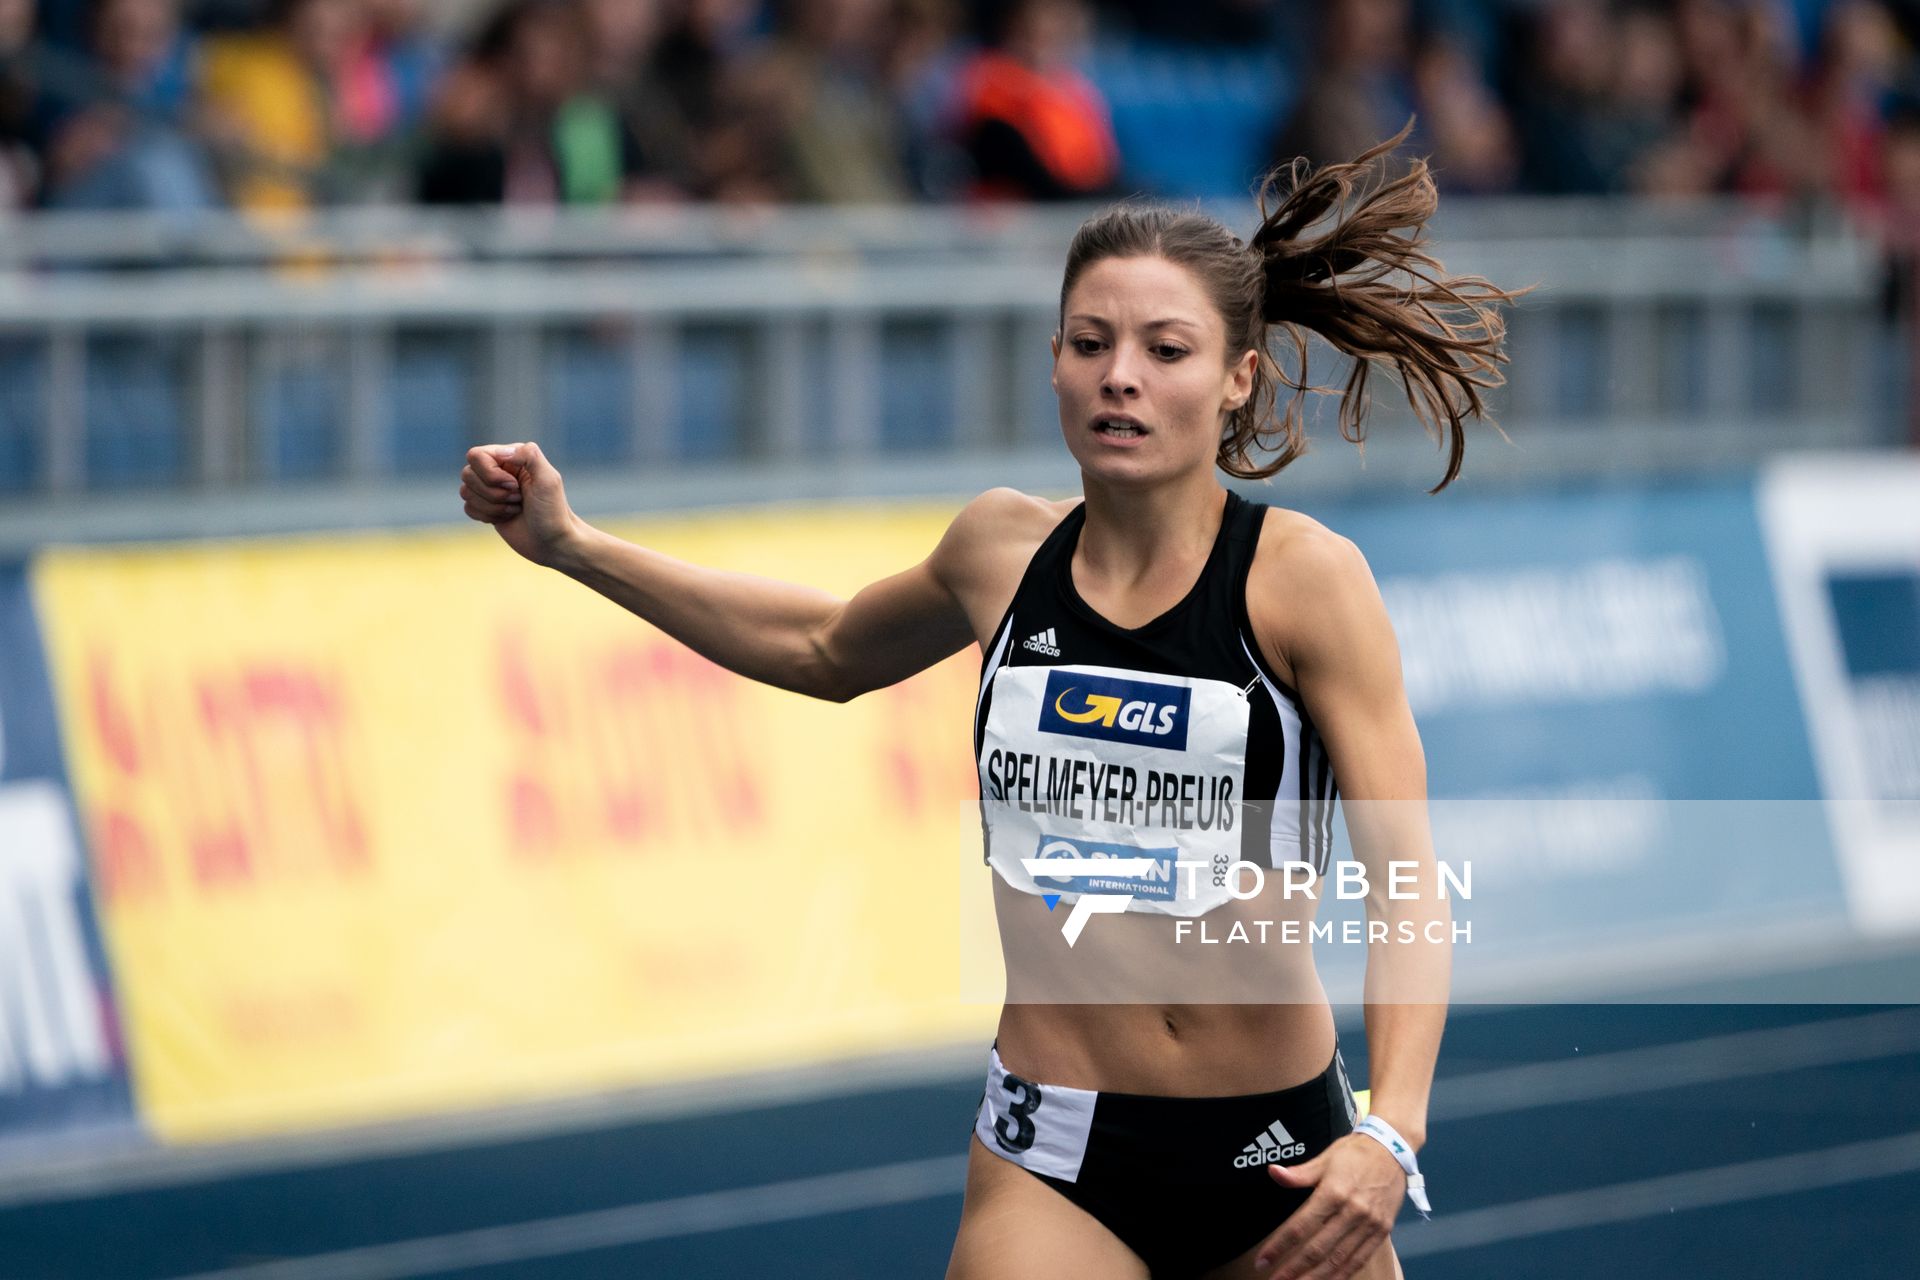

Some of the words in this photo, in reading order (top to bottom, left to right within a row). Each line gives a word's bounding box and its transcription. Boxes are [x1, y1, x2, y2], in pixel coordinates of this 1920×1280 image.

[1022, 638, 1062, 658] adidas
[1117, 700, 1178, 735] GLS
[987, 748, 1234, 832] SPELMEYER-PREUß
[1088, 878, 1170, 895] INTERNATIONAL
[1212, 853, 1230, 888] 338
[993, 1073, 1042, 1155] 3
[1233, 1142, 1306, 1169] adidas
